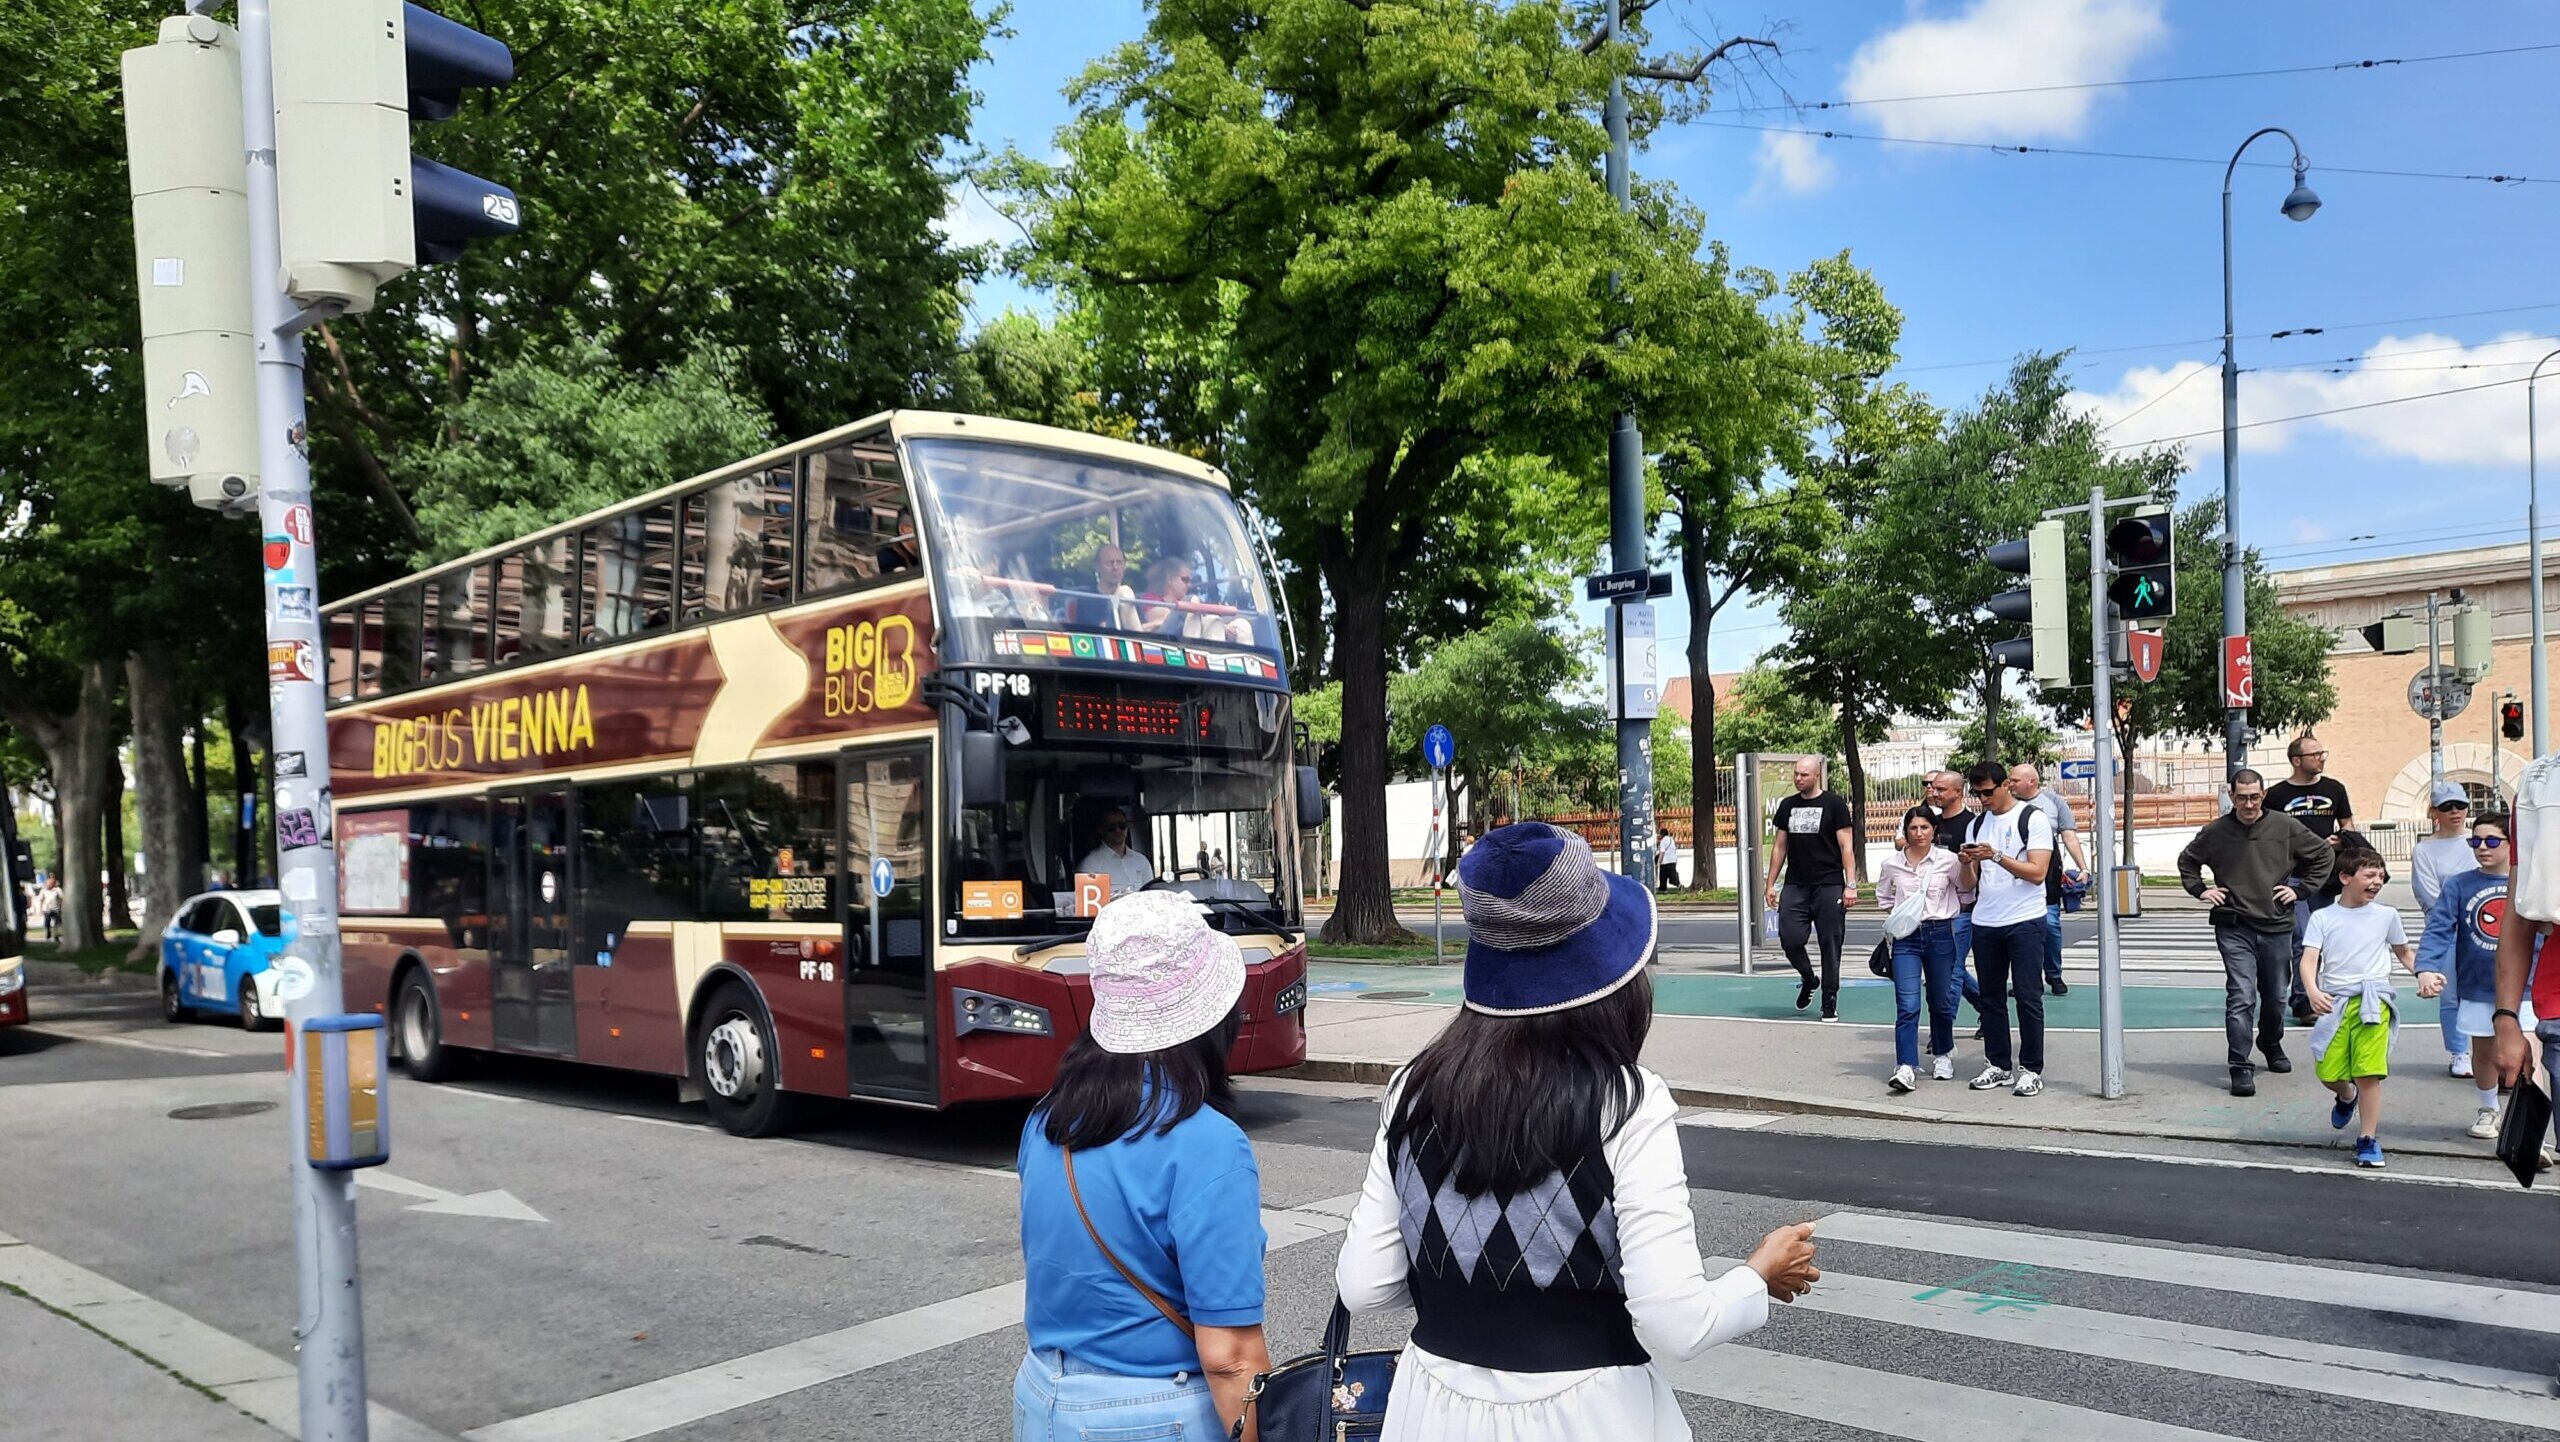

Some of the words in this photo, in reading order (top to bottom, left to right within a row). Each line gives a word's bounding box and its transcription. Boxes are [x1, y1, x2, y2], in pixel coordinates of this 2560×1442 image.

[484, 194, 514, 220] 25
[1606, 578, 1636, 591] Burgring
[826, 620, 875, 673] BIG
[825, 670, 873, 717] BUS
[471, 683, 594, 764] VIENNA
[818, 961, 834, 982] 18
